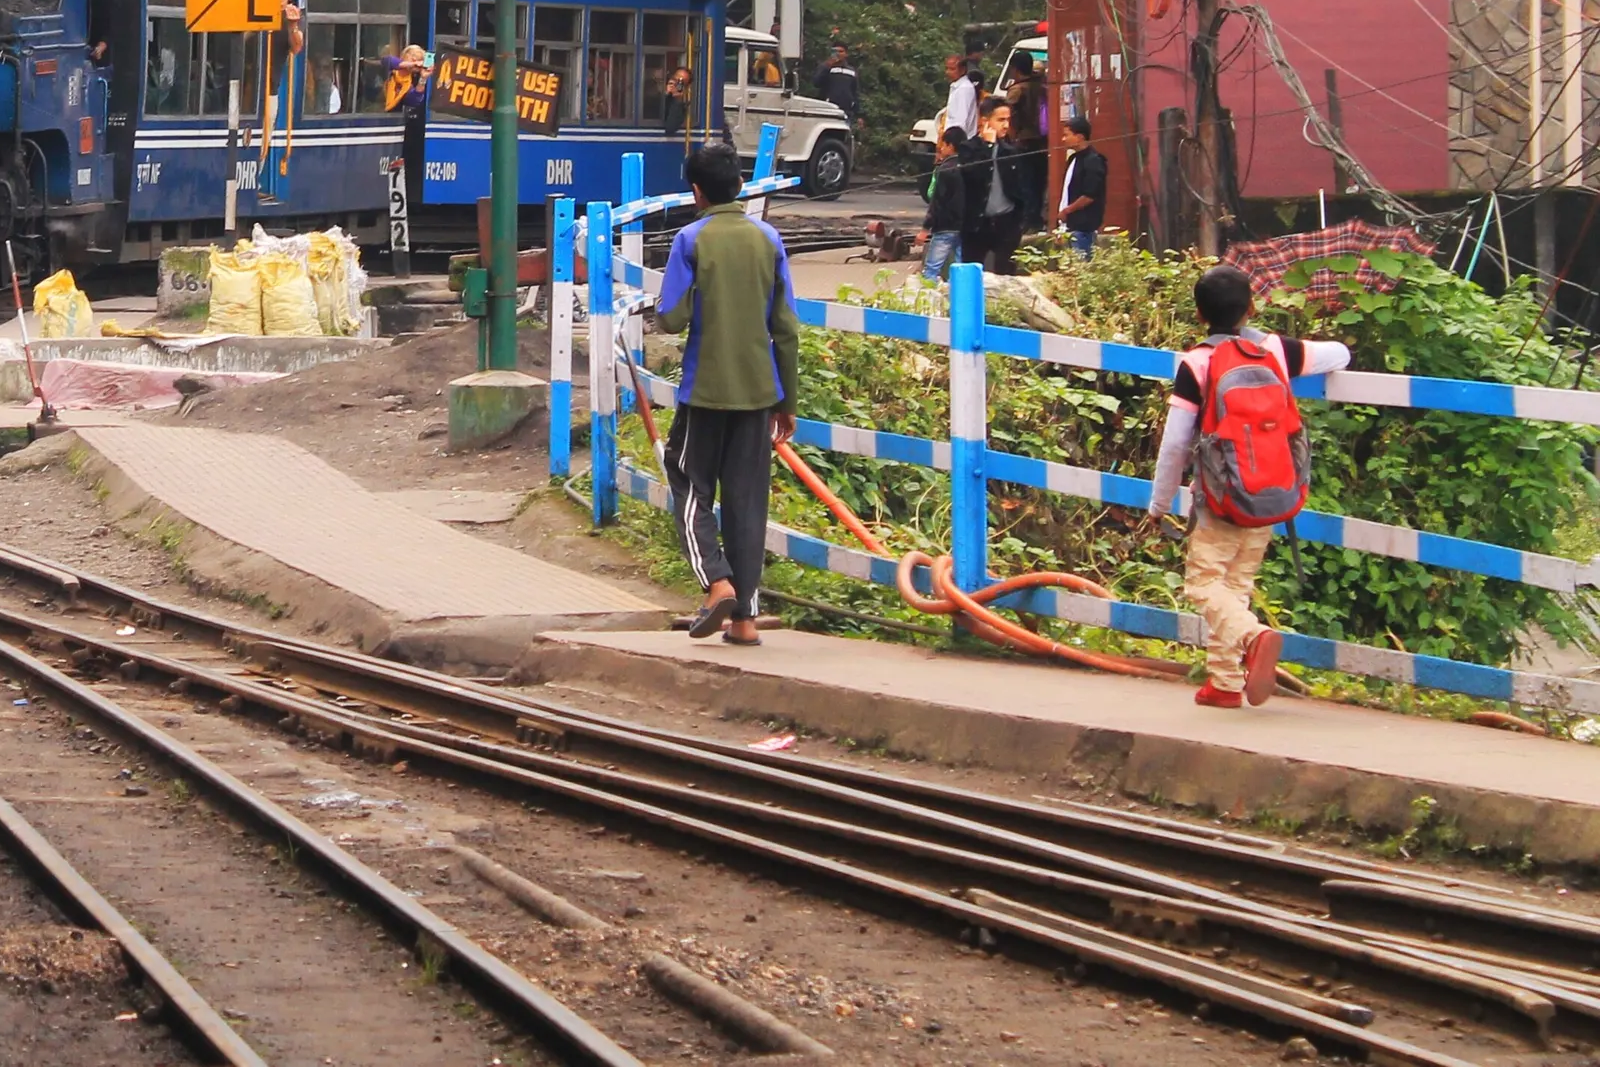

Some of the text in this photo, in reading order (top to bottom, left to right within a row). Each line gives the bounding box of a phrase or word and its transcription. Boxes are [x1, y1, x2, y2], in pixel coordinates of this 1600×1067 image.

[523, 70, 559, 96] USE
[236, 160, 257, 190] DHR
[425, 161, 457, 181] FCZ-109
[546, 159, 573, 185] DHR
